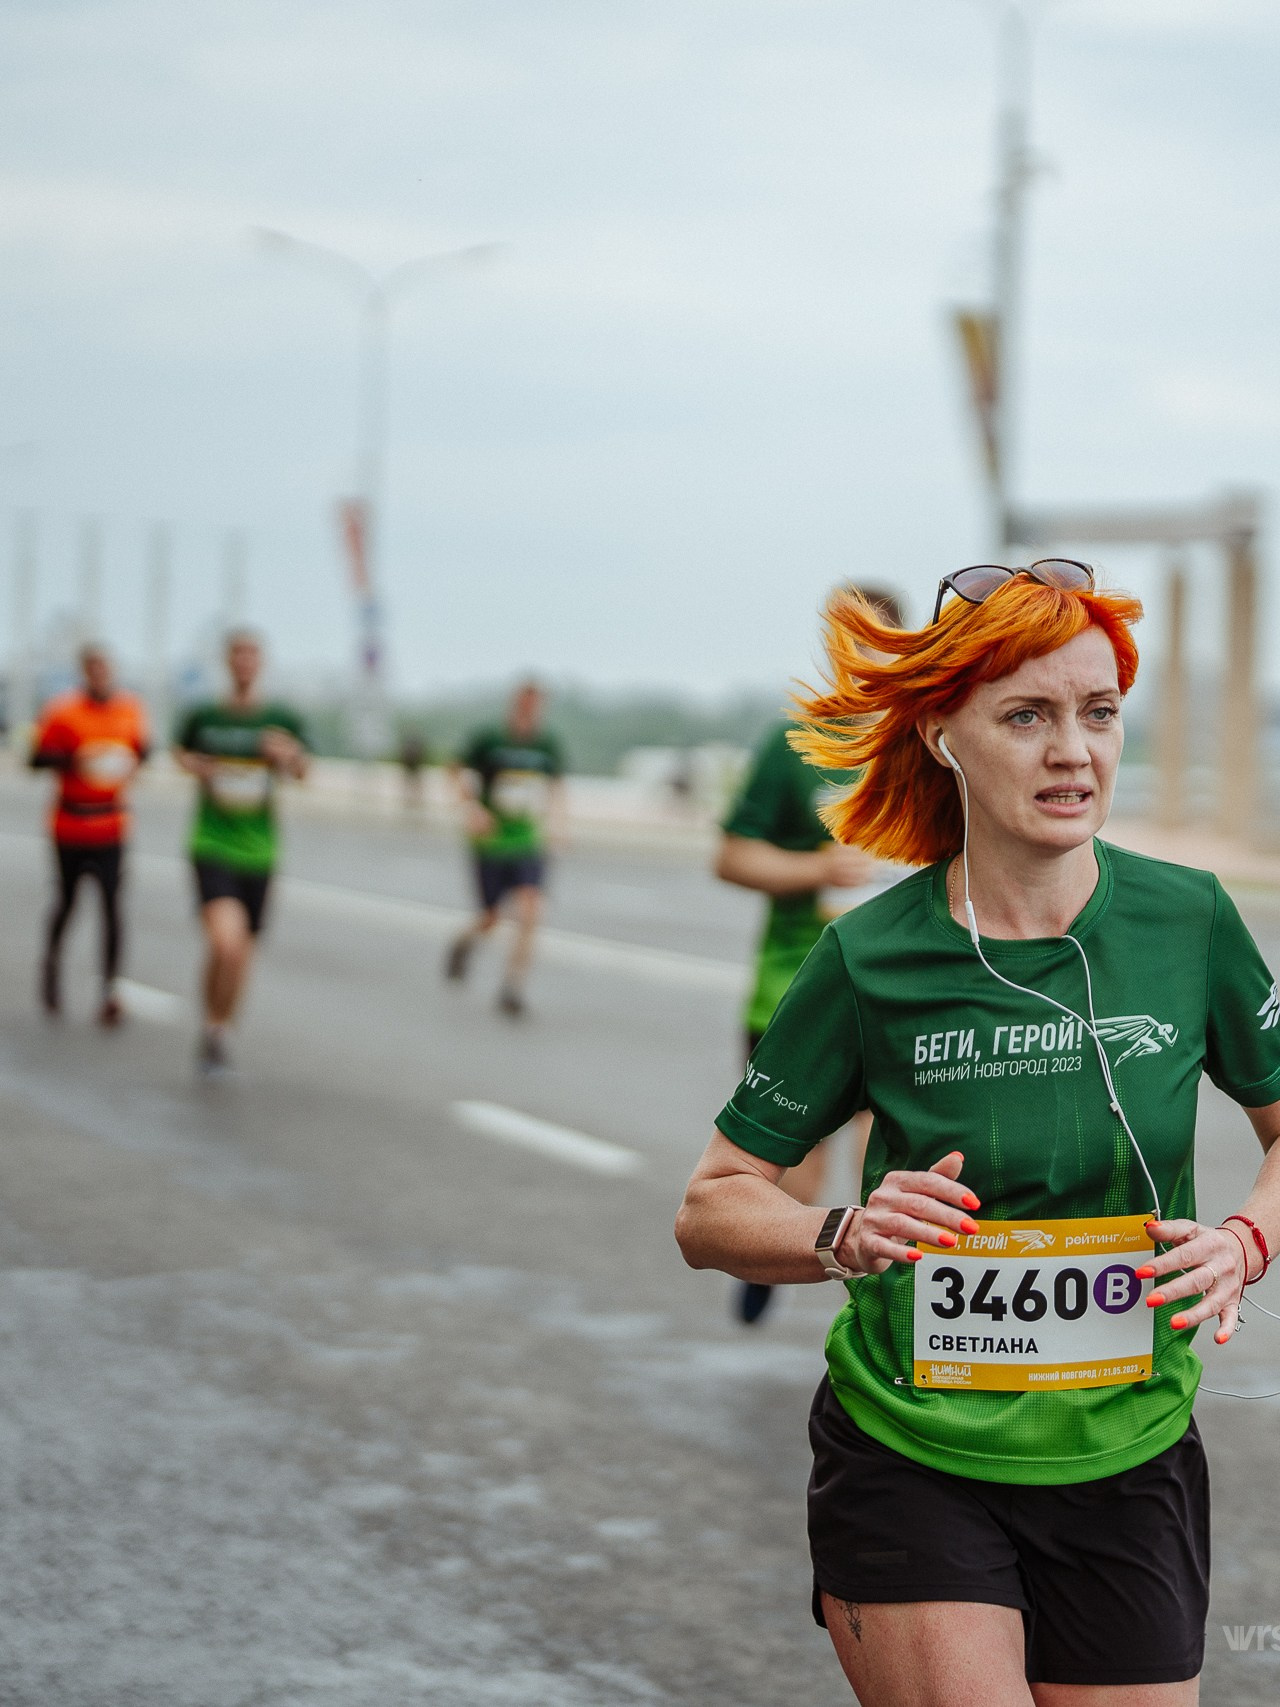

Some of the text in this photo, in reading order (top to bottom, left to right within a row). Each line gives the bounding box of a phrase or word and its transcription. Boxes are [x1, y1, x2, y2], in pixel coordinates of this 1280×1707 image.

[914, 1015, 1083, 1065] БЕГИ, ГЕРОЙ!
[914, 1056, 1082, 1086] НИЖНИЙ НОВГОРОД 2023
[966, 1233, 1008, 1250] ГЕРОЙ!
[931, 1266, 1088, 1322] 3460
[929, 1334, 1039, 1353] СВЕТЛАНА
[1028, 1370, 1059, 1381] НИЖНИЙ
[1062, 1369, 1097, 1380] НОВГОРОД
[1103, 1364, 1138, 1376] 21.05.2023
